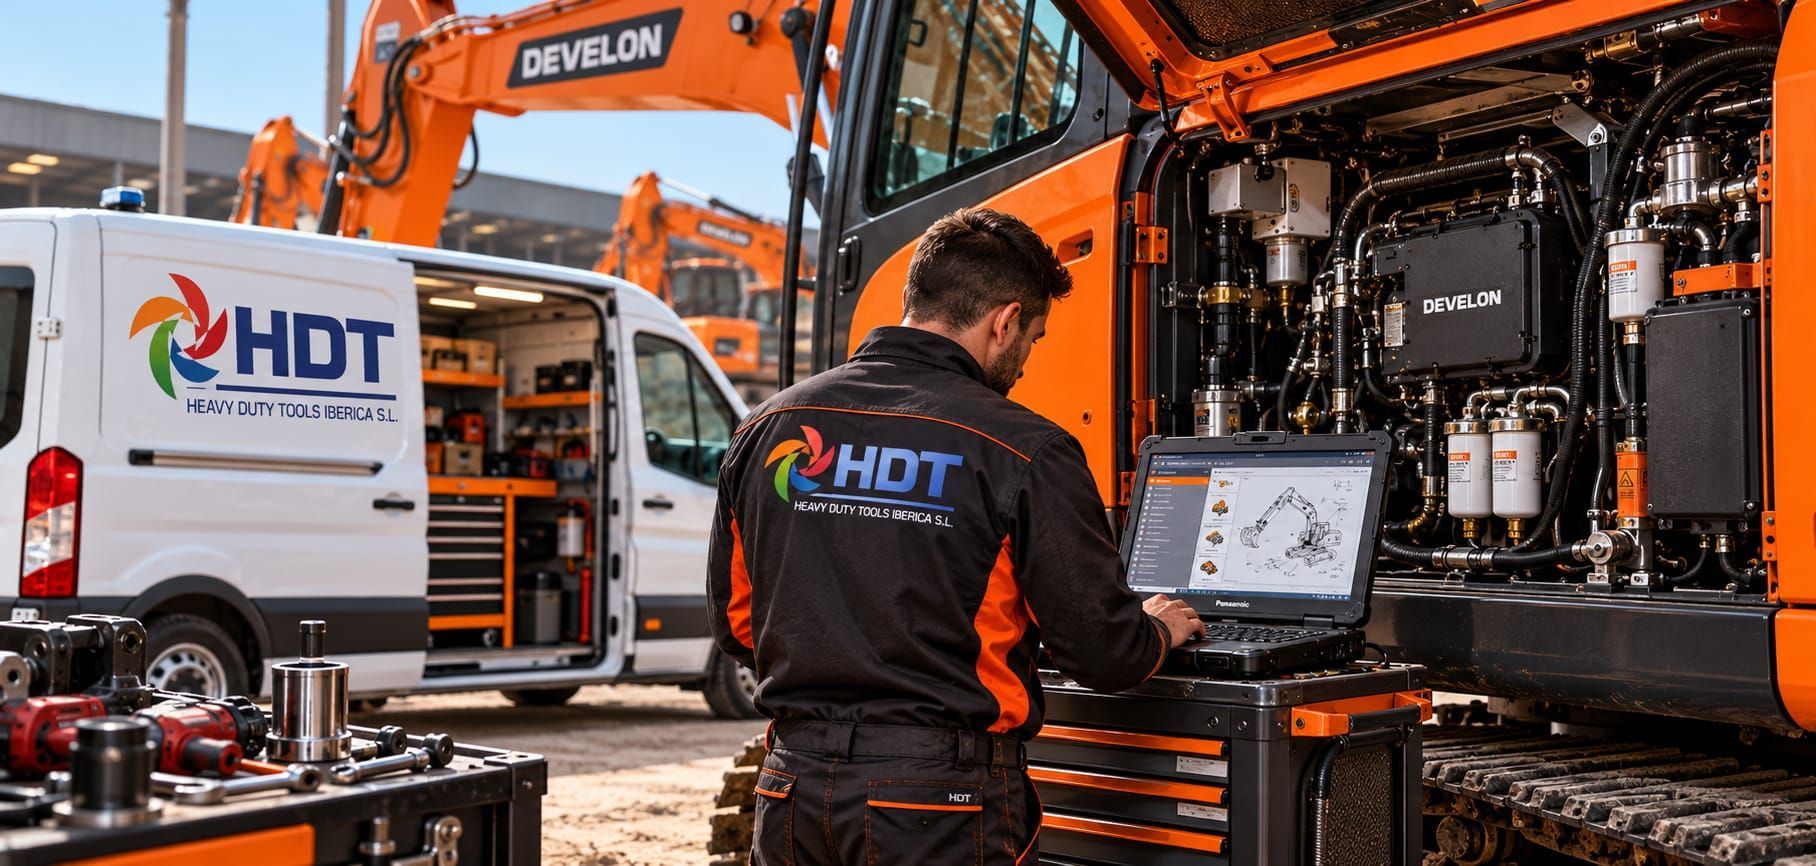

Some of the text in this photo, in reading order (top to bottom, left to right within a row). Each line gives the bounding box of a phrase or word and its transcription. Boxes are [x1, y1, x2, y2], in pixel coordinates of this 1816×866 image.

[522, 24, 663, 79] DEVELON
[1423, 289, 1502, 315] DEVELON
[235, 306, 394, 383] HDT
[186, 398, 398, 423] HEAVY DUTY TOOLS IBERICA S.L.
[833, 443, 963, 498] HDT
[794, 500, 954, 528] HEAVY DUTY TOOLS IBERICA S.L.
[948, 793, 972, 803] HDT
